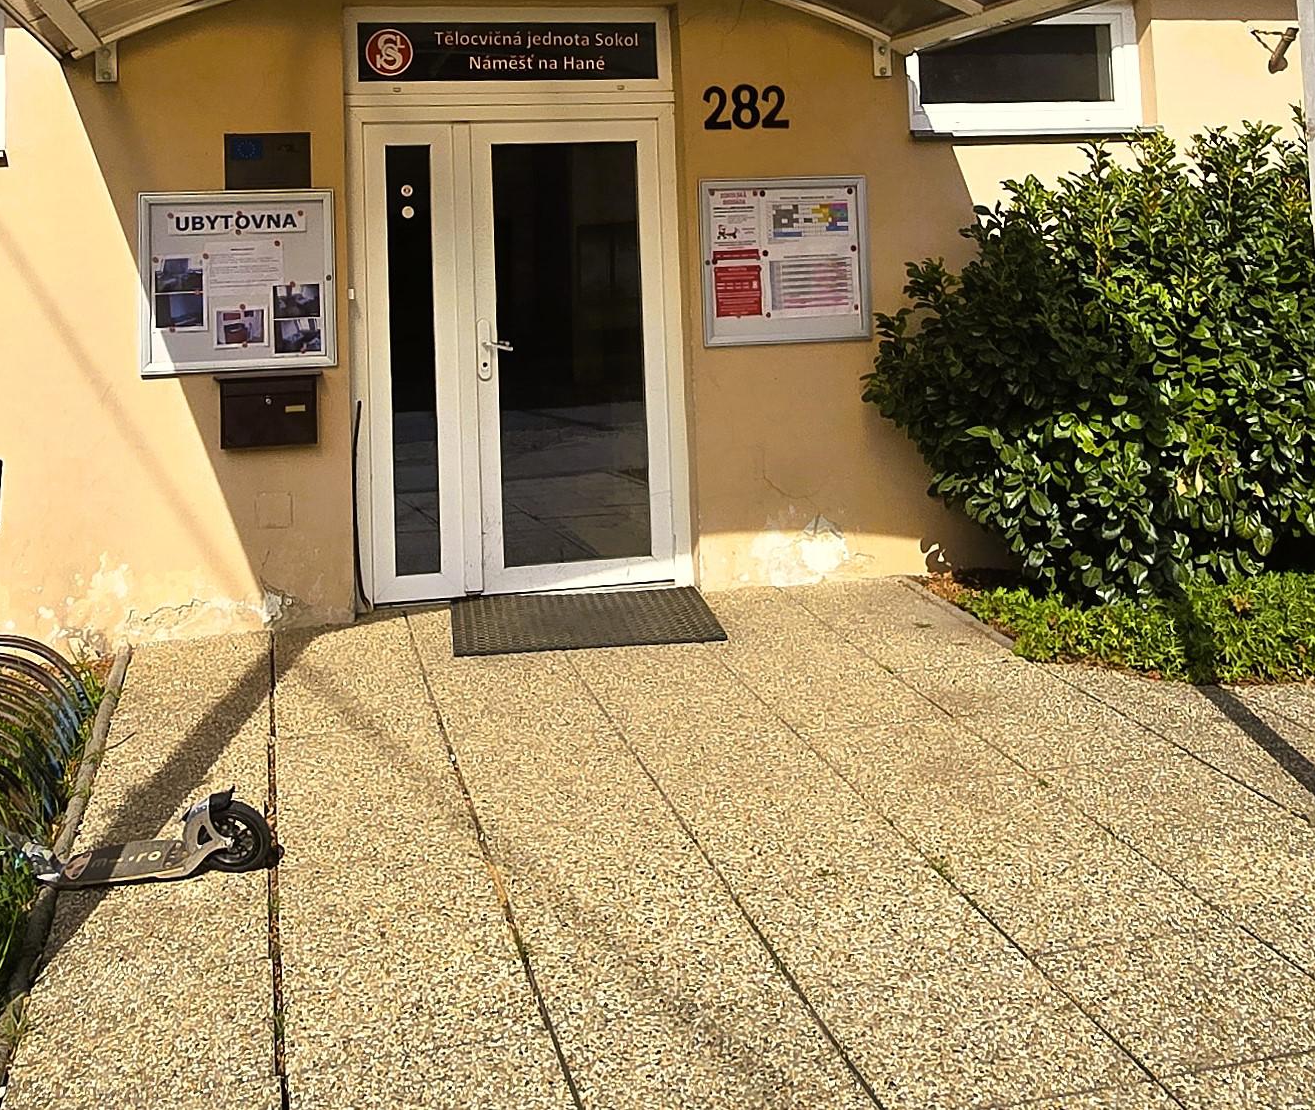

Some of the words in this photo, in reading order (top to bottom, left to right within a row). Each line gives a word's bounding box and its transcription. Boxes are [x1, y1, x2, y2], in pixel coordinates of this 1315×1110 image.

[433, 30, 522, 46] Tělocvičná
[526, 30, 590, 49] jednota
[594, 32, 639, 47] Sokol
[469, 53, 535, 70] Náměšť
[538, 58, 558, 70] na
[563, 54, 605, 70] Hané
[702, 83, 790, 131] 282
[175, 213, 298, 232] UBYTOVNA
